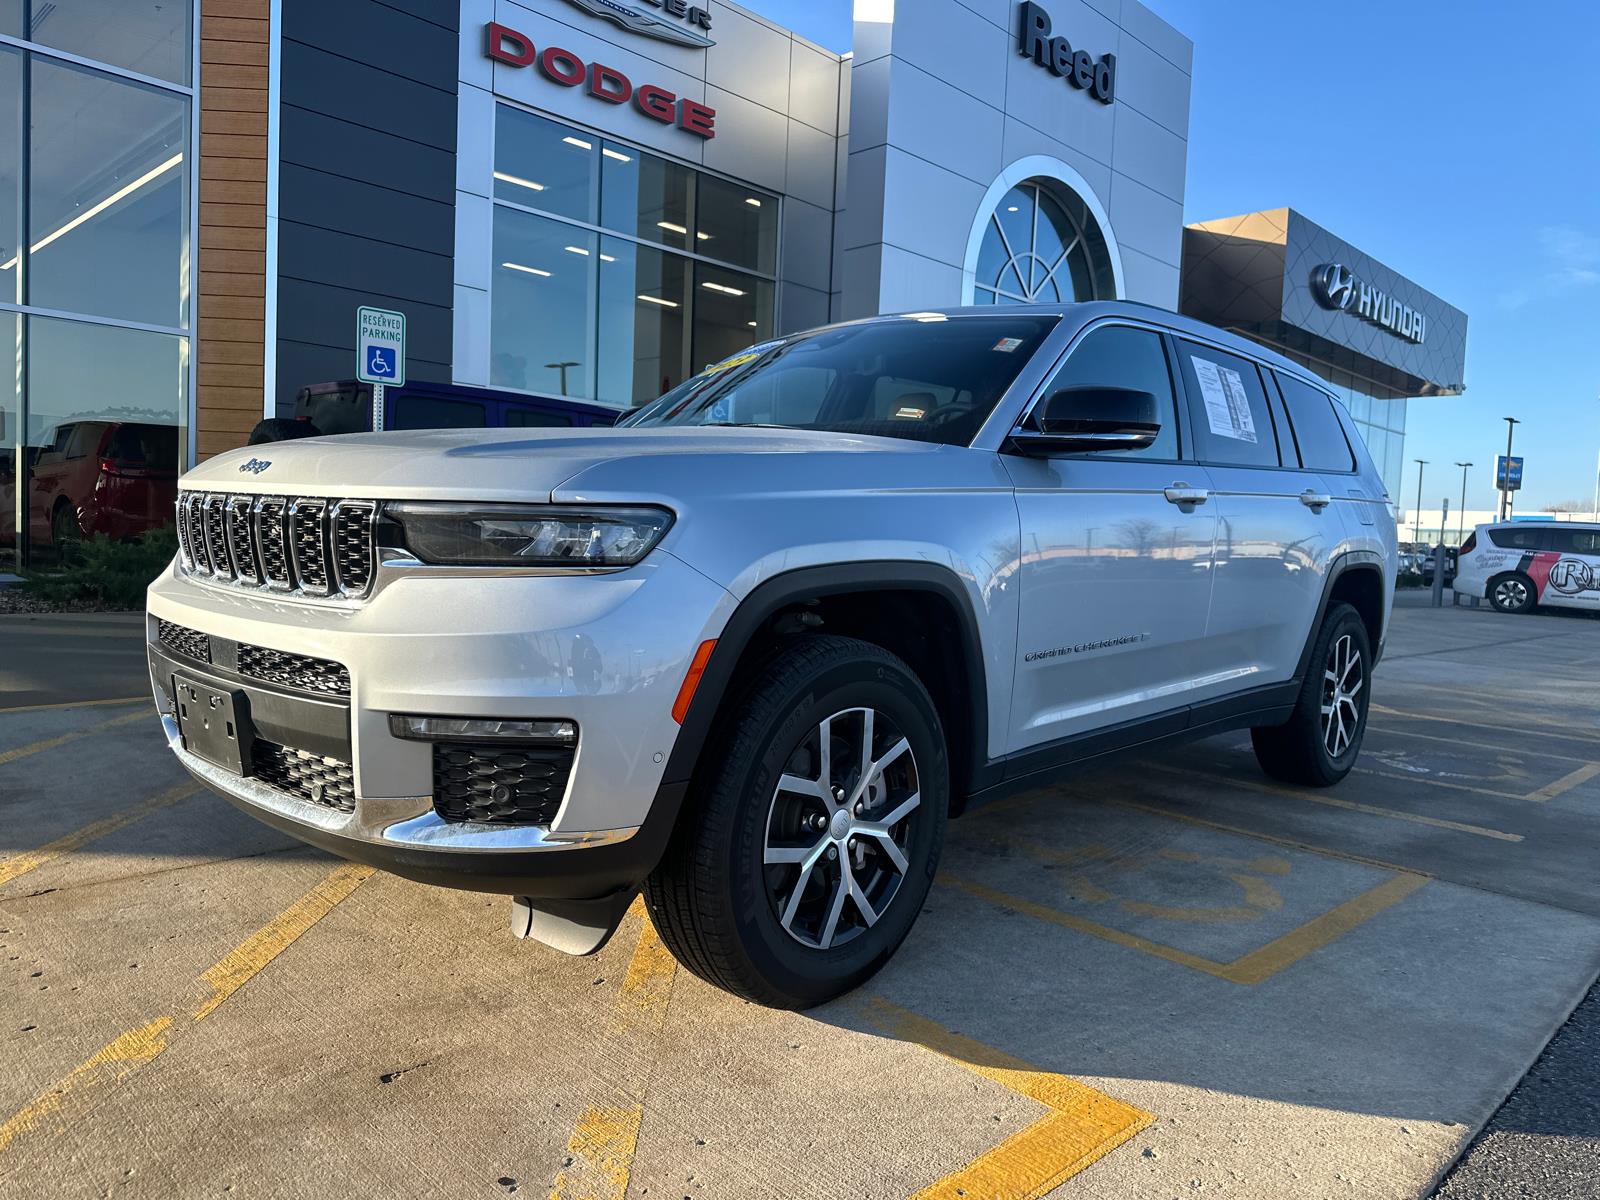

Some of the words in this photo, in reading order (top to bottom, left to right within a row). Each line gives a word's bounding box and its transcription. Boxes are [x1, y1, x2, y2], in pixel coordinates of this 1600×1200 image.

[1019, 0, 1116, 105] Reed
[485, 21, 716, 139] DODGE
[362, 314, 401, 330] RESERVED
[1358, 281, 1426, 344] HYUNDAI
[362, 327, 401, 342] PARKING
[239, 457, 272, 475] Jeep
